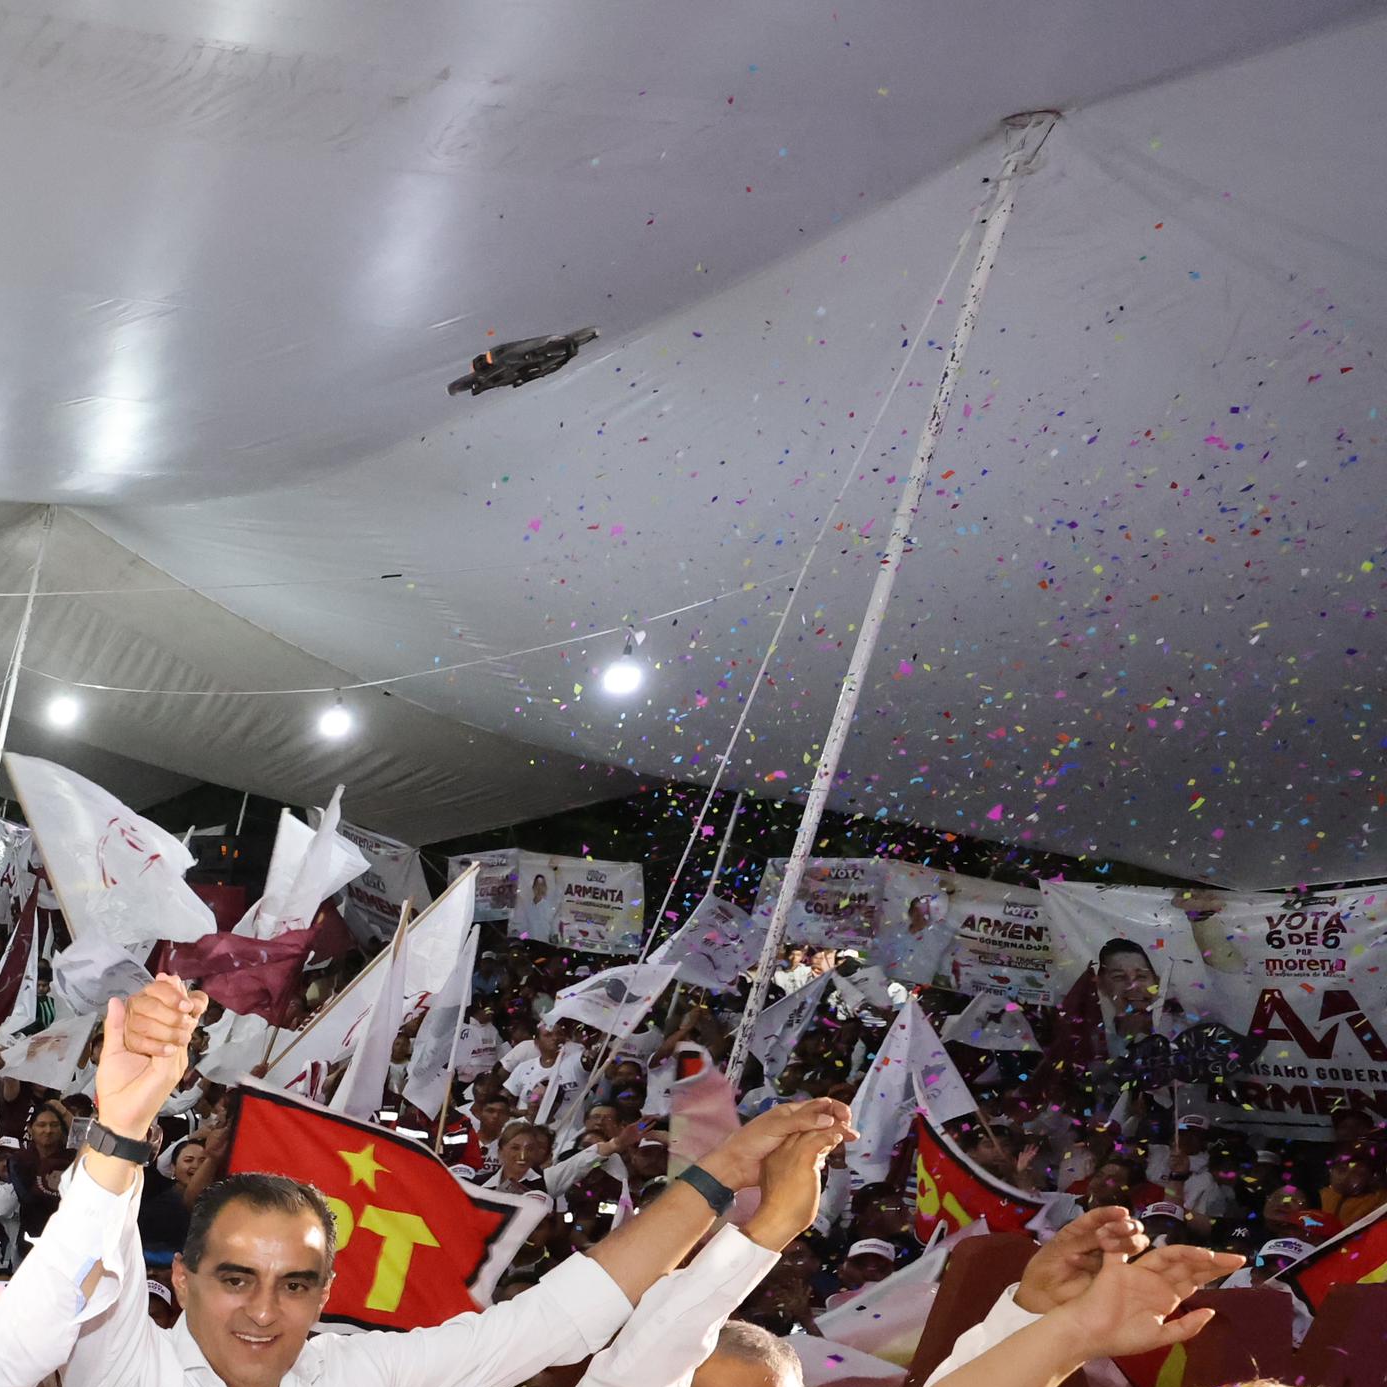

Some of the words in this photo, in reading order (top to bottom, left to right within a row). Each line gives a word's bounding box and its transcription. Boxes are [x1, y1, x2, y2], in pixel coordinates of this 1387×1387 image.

[830, 868, 865, 880] VOTA
[564, 883, 624, 903] ARMENTA
[1005, 904, 1038, 920] VOTA
[1265, 911, 1348, 933] VOTA
[979, 937, 1051, 952] GOBERNADOR
[1265, 957, 1347, 972] morena
